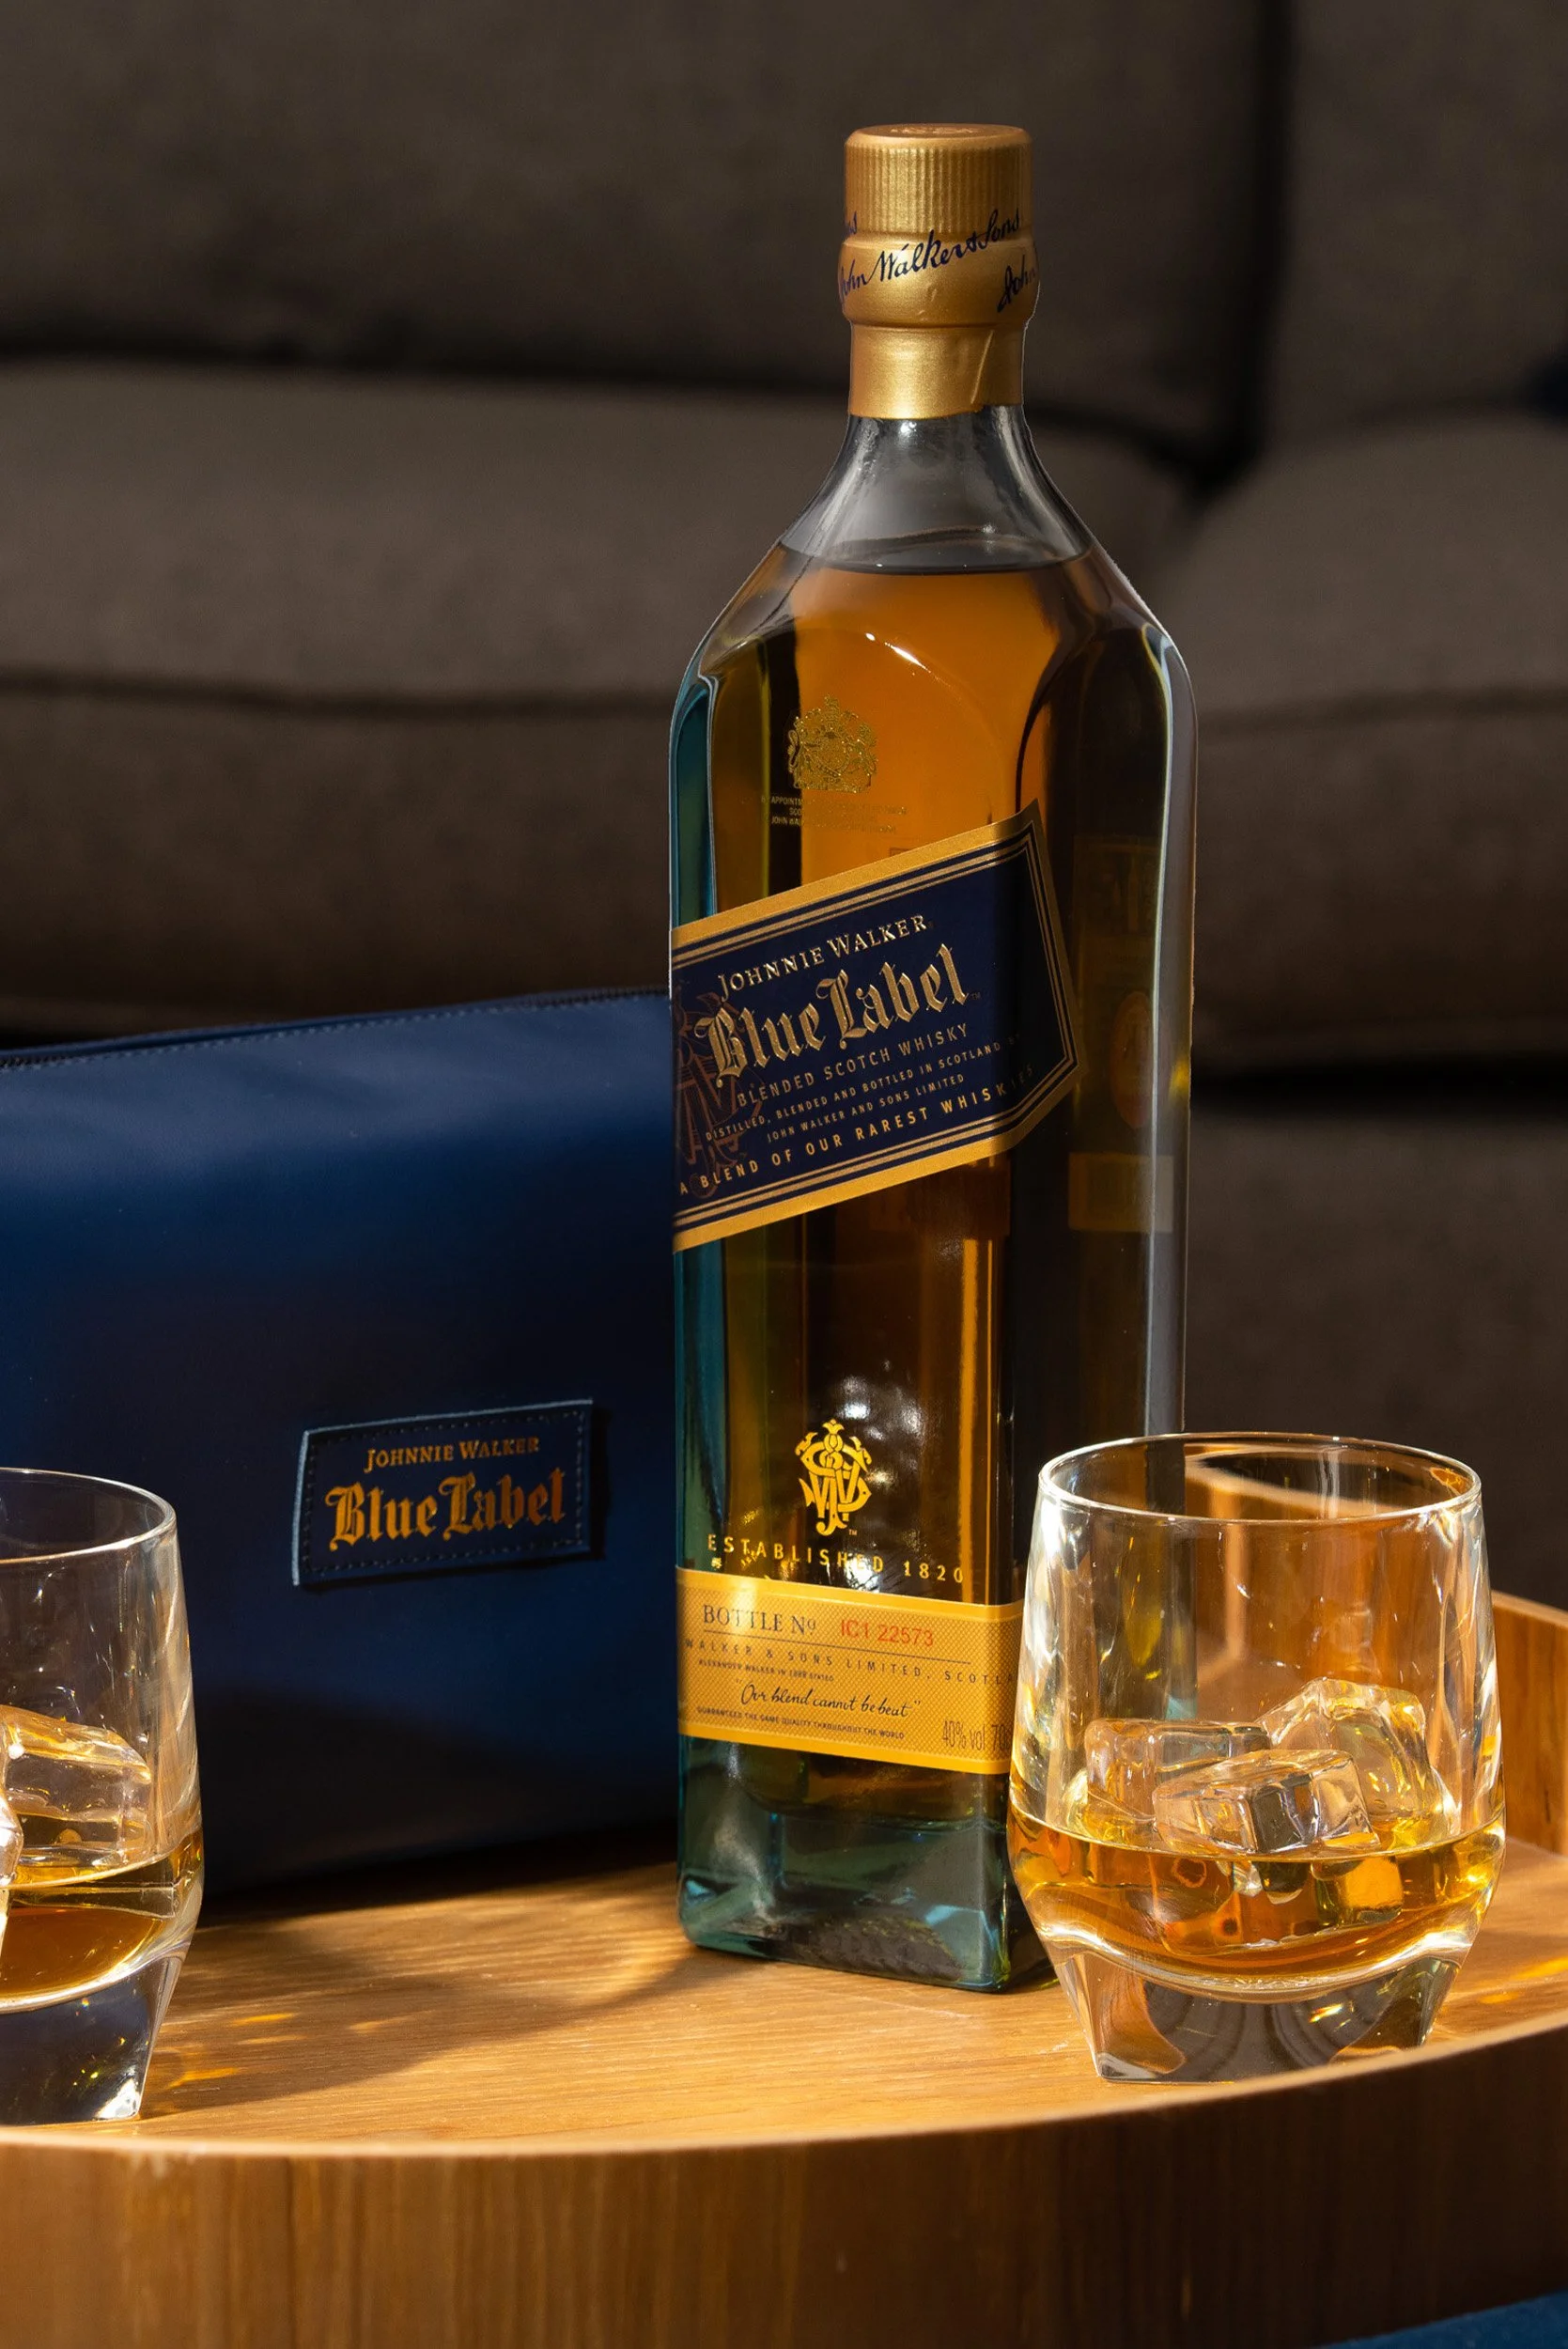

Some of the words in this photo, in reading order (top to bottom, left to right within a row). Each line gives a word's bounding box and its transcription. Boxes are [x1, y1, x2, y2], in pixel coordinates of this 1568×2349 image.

[718, 946, 825, 1003] JOHNNIE
[827, 914, 928, 958] WALKER
[693, 1002, 827, 1089] Blue
[815, 942, 970, 1050] Label
[737, 1071, 815, 1108] BLENDED
[823, 1048, 892, 1082] SCOTCH
[897, 1022, 969, 1057] WHISKY
[775, 1096, 829, 1120] BLENDED
[833, 1087, 857, 1102] AND
[862, 1068, 914, 1093] BOTTLED
[919, 1063, 933, 1075] IN
[939, 1041, 1001, 1069] SCOTLAND
[767, 1126, 796, 1143] JOHN
[800, 1109, 846, 1131] WALKER
[851, 1101, 874, 1116] AND
[878, 1090, 910, 1108] SONS
[915, 1073, 965, 1097] LIMITED
[679, 1181, 689, 1196] A
[699, 1159, 759, 1189] BLEND
[770, 1148, 792, 1166] OF
[805, 1133, 843, 1157] OUR
[855, 1106, 928, 1141] RAREST
[363, 1444, 454, 1473] JOHNNIE
[459, 1436, 540, 1460] WALKER
[324, 1481, 438, 1552] Blue
[438, 1466, 566, 1542] Label
[707, 1532, 884, 1574] ESTABLISHED
[903, 1560, 964, 1584] 1820
[684, 1638, 753, 1655] WALKER
[787, 1650, 834, 1666] SONS
[944, 1670, 1018, 1685] SCOTLA
[703, 1604, 784, 1633] BOTTLE
[877, 1624, 934, 1647] 22573
[770, 1686, 814, 1705] blend
[812, 1695, 858, 1712] cannot
[861, 1694, 876, 1713] be
